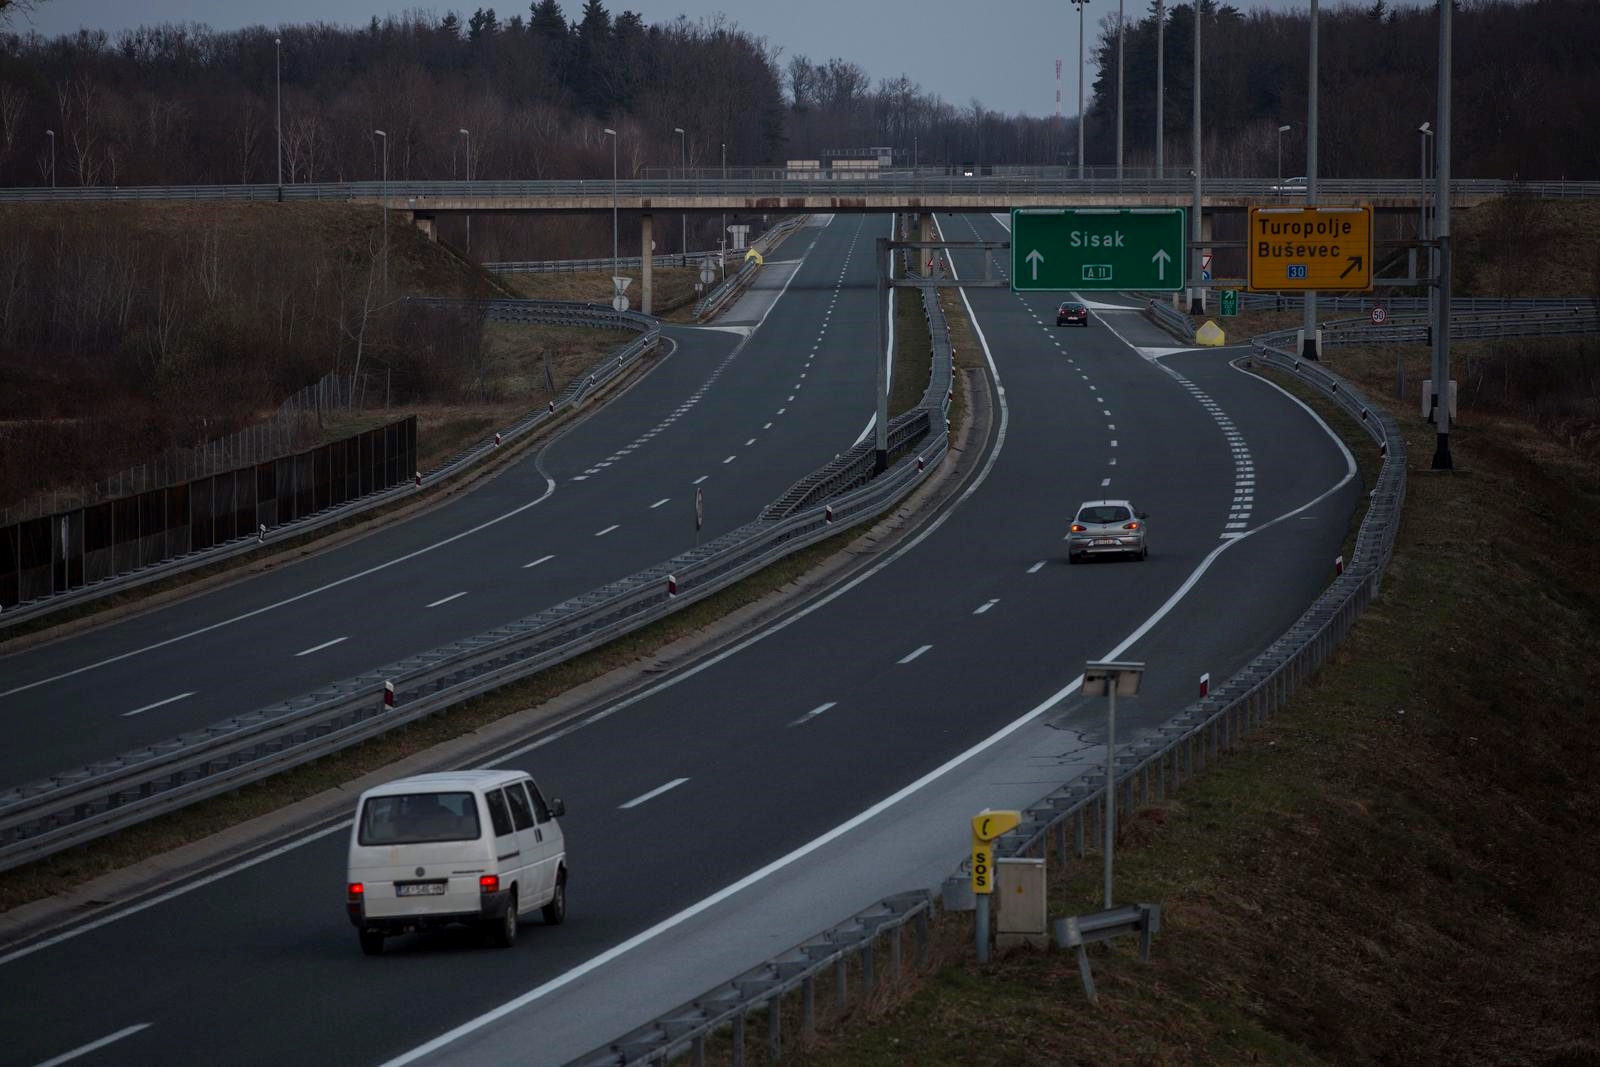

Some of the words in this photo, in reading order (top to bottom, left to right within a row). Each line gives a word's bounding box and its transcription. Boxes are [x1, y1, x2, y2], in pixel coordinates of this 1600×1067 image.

[1259, 218, 1351, 238] Turopolje
[1070, 230, 1125, 247] Sisak
[1258, 241, 1340, 257] Buševec
[1087, 267, 1095, 278] A
[1098, 267, 1106, 278] 11
[1290, 266, 1305, 277] 30
[1374, 310, 1384, 320] 50
[976, 852, 987, 887] SOS
